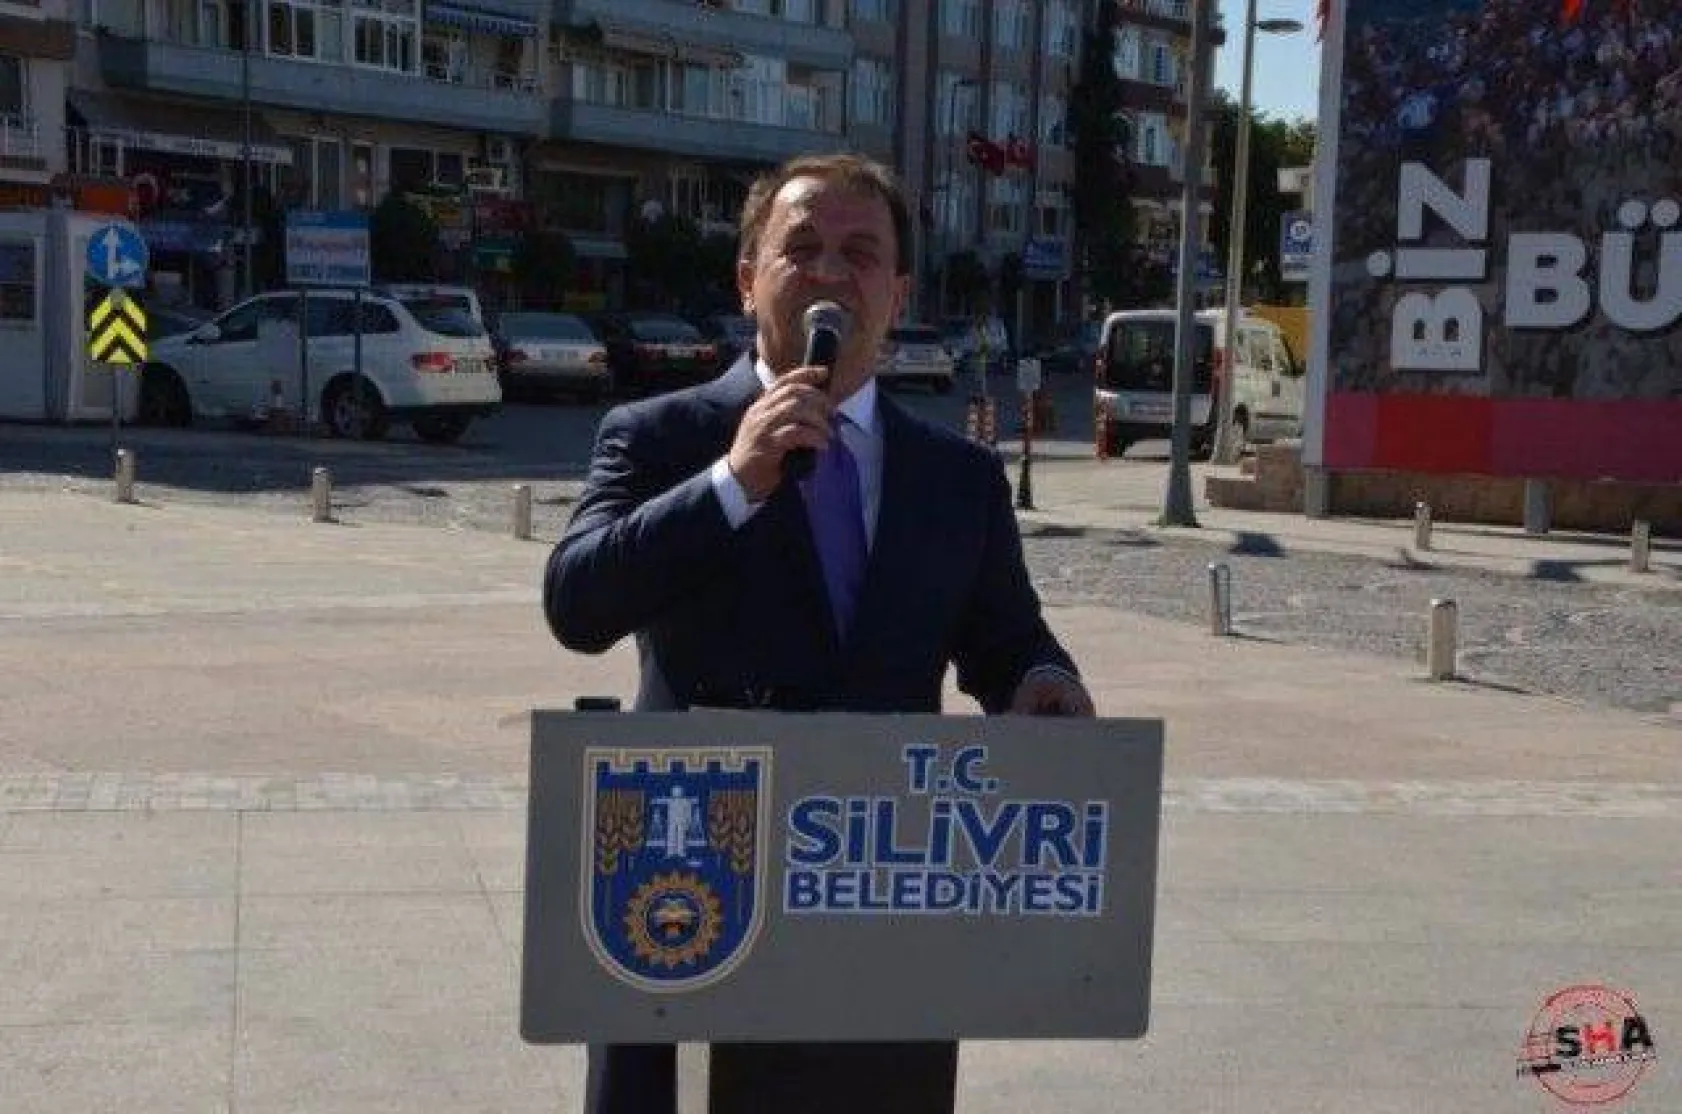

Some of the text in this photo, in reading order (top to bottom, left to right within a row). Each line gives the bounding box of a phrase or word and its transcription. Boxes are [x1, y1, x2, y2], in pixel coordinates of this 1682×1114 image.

[1366, 157, 1491, 369] BİN
[1505, 199, 1682, 329] BÜ
[902, 744, 999, 792] T.C.
